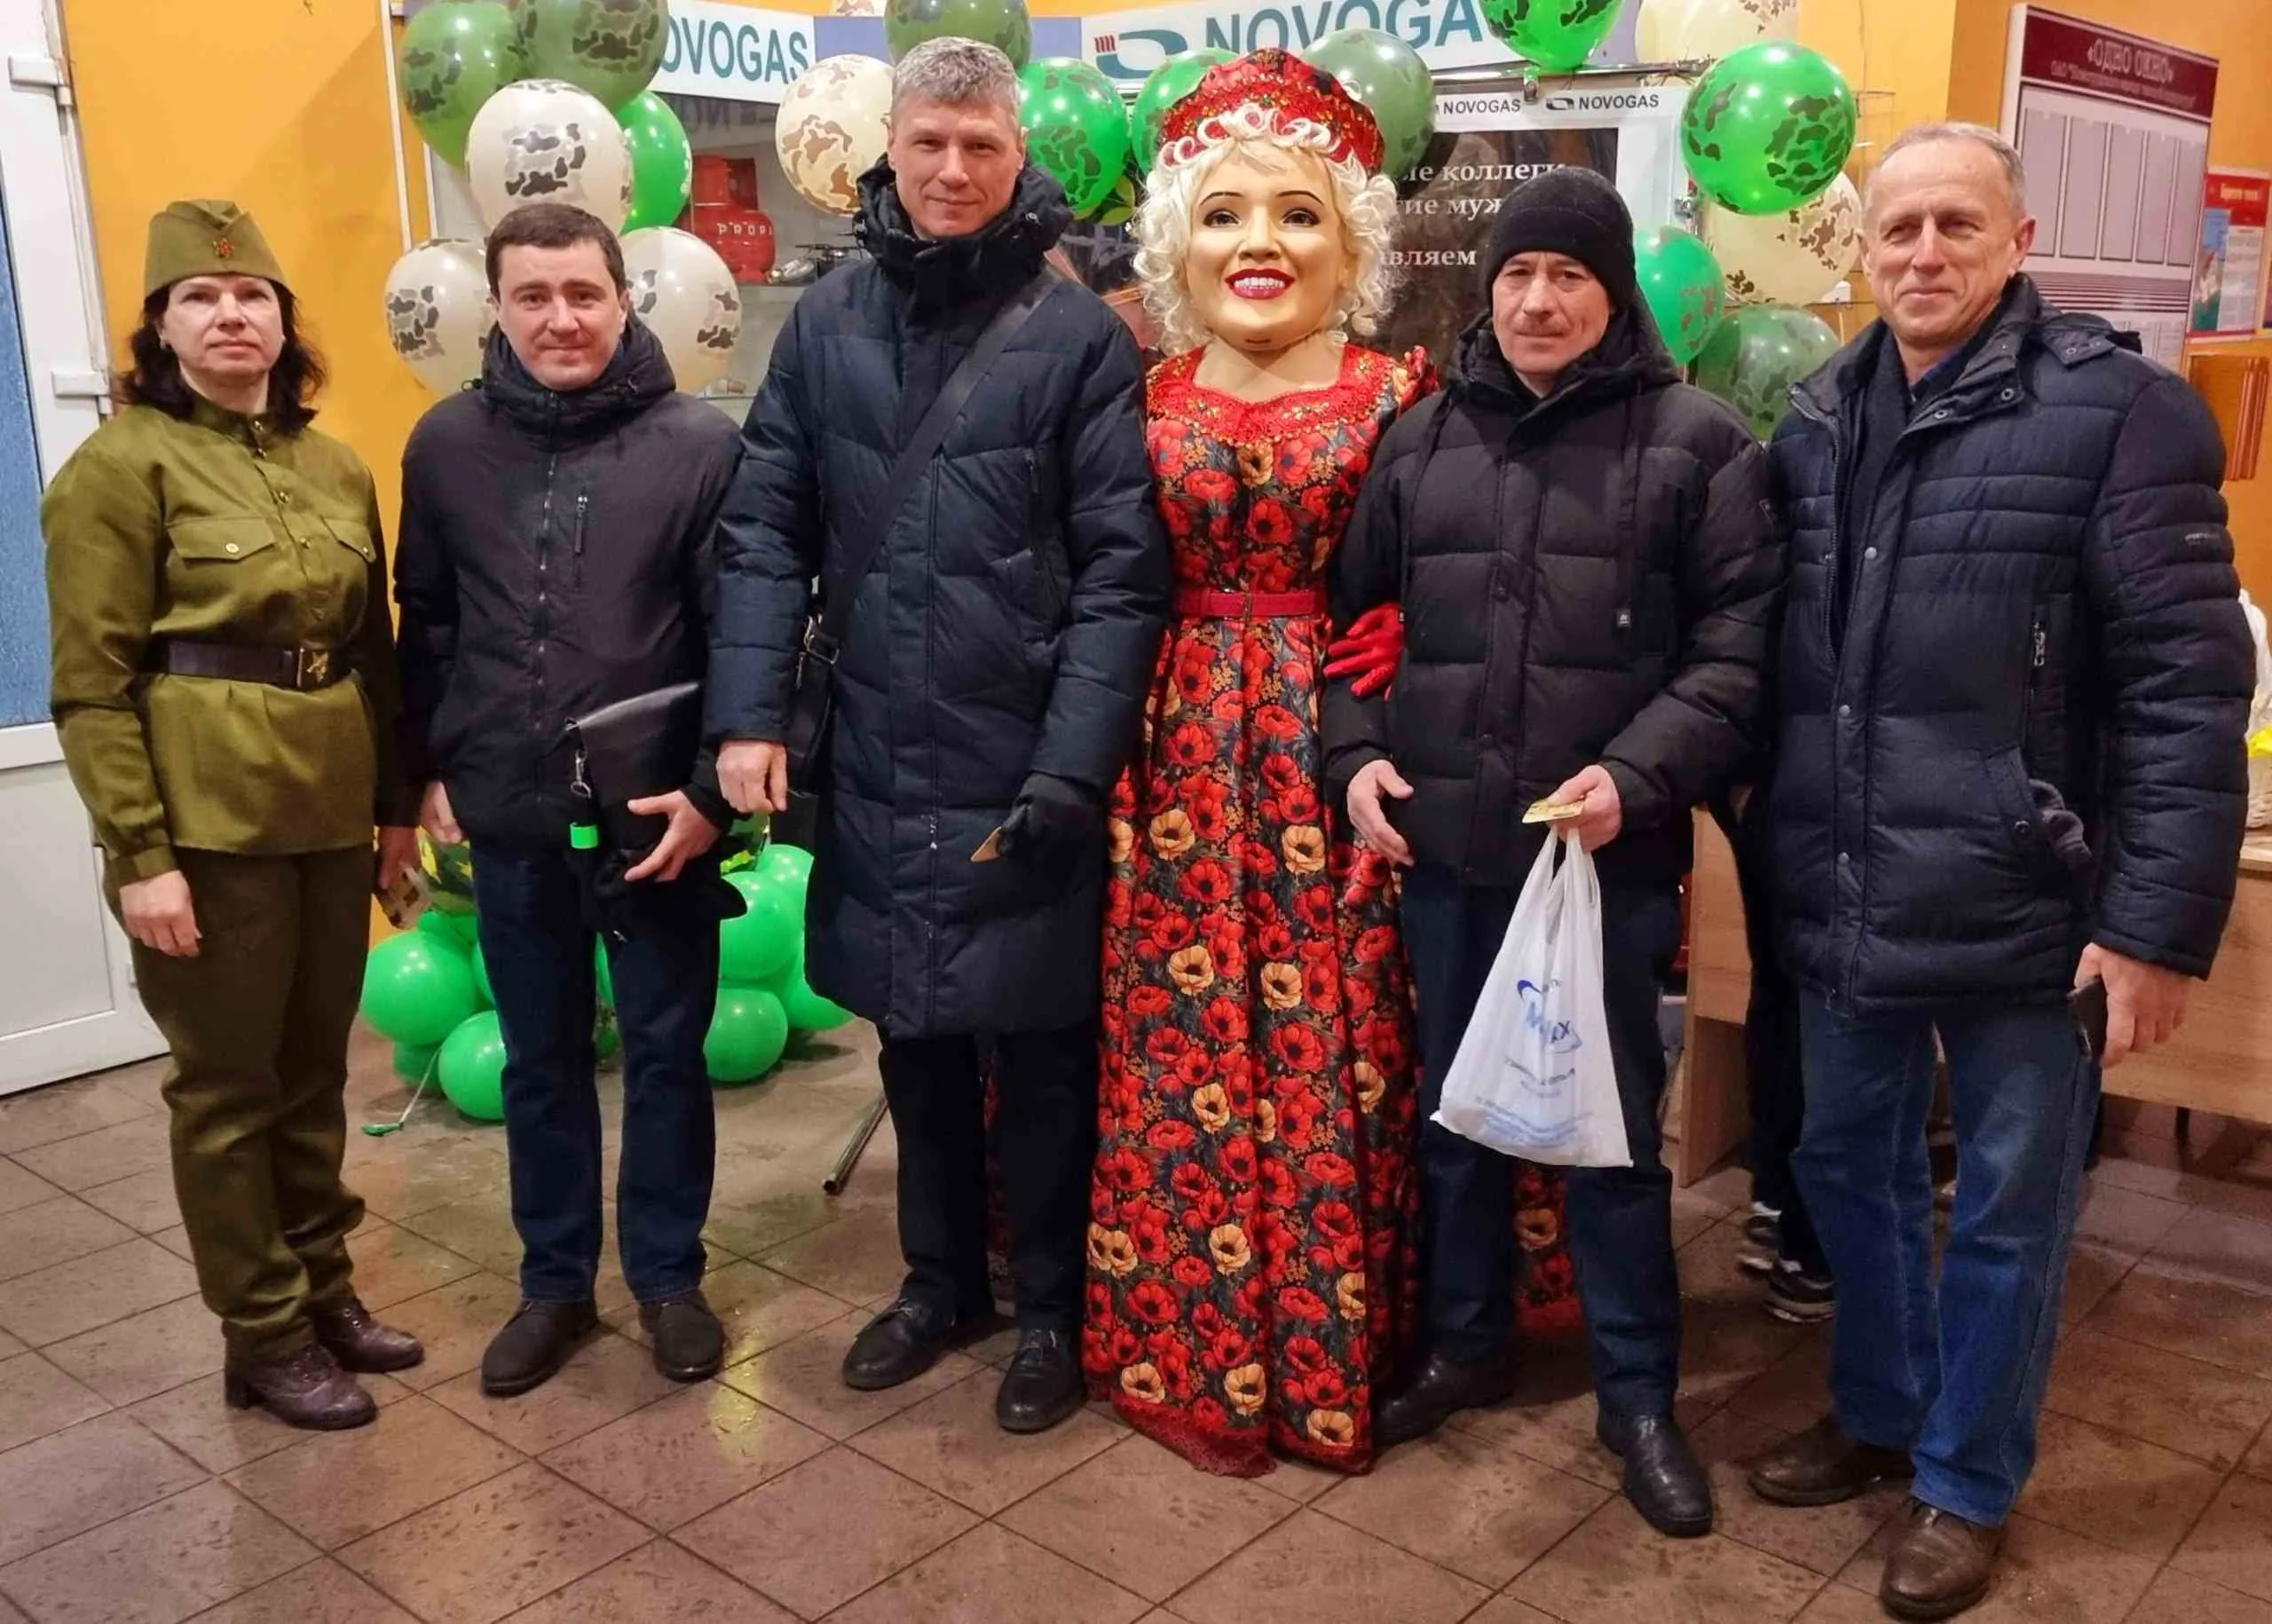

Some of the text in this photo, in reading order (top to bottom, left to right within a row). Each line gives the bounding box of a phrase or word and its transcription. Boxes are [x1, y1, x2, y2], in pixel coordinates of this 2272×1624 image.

[1205, 0, 1483, 53] NOVOGA
[661, 15, 809, 84] OVOGAS
[1443, 94, 1660, 114] NOVOGAS NOVOGAS
[1448, 198, 1503, 221] муж
[1387, 249, 1478, 266] вляем
